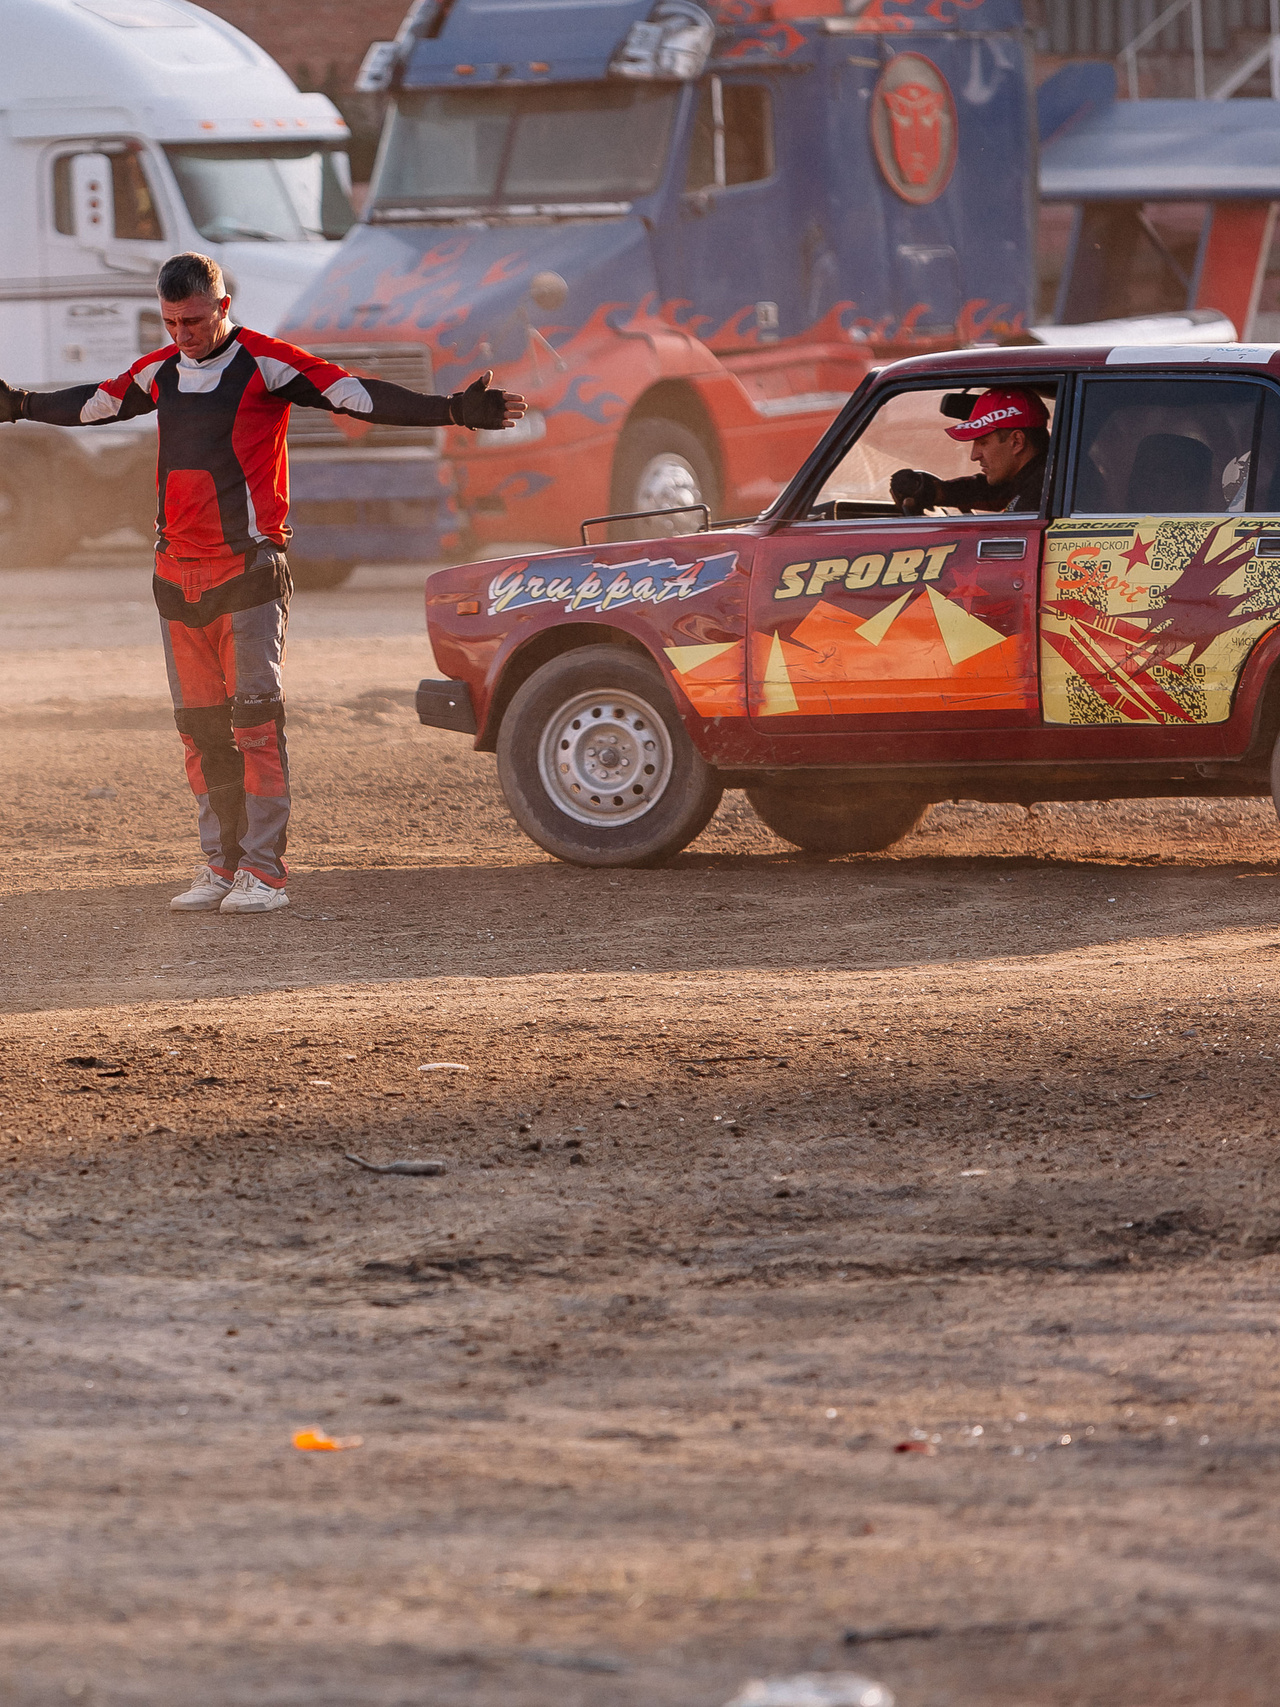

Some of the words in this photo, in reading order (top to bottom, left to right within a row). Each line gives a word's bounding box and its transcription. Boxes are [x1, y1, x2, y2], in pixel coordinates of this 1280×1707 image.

[955, 406, 1023, 431] HONDA
[774, 542, 959, 600] SPORT
[1055, 546, 1150, 603] Sport
